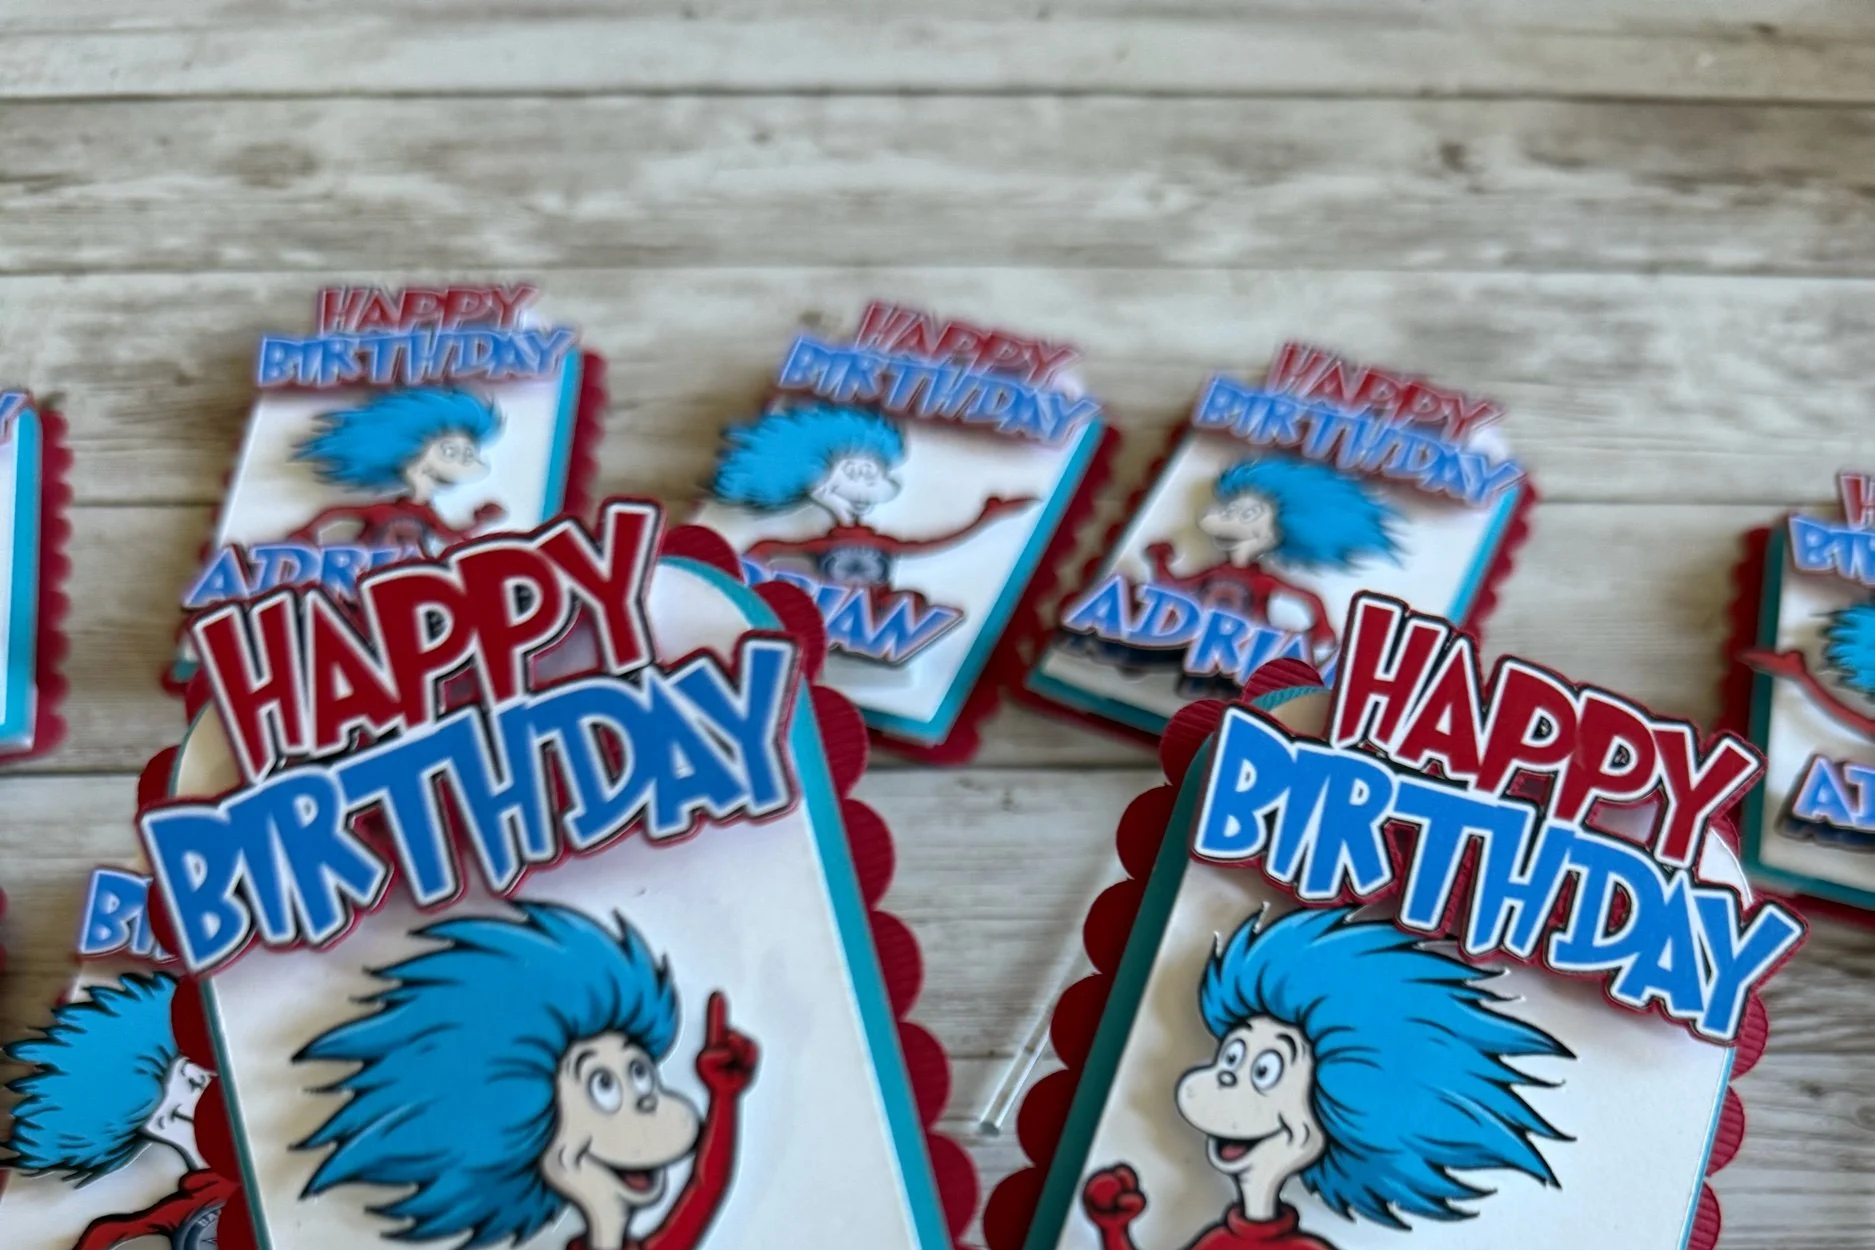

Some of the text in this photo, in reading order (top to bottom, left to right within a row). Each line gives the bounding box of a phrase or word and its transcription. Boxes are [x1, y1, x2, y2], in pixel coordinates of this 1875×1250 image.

[258, 329, 574, 386] BIRTHDAY
[317, 286, 538, 332] HAPPY
[854, 301, 1085, 387] HAPPY
[779, 335, 1101, 444] BIRTHDAY
[1195, 377, 1525, 503] BIRTHDAY
[1268, 342, 1500, 442] HAPPY
[193, 503, 657, 784] HAPPY
[1333, 597, 1760, 867] HAPPY
[141, 638, 795, 970] BIRTHDAY
[1193, 708, 1802, 1040] BIRTHDAY
